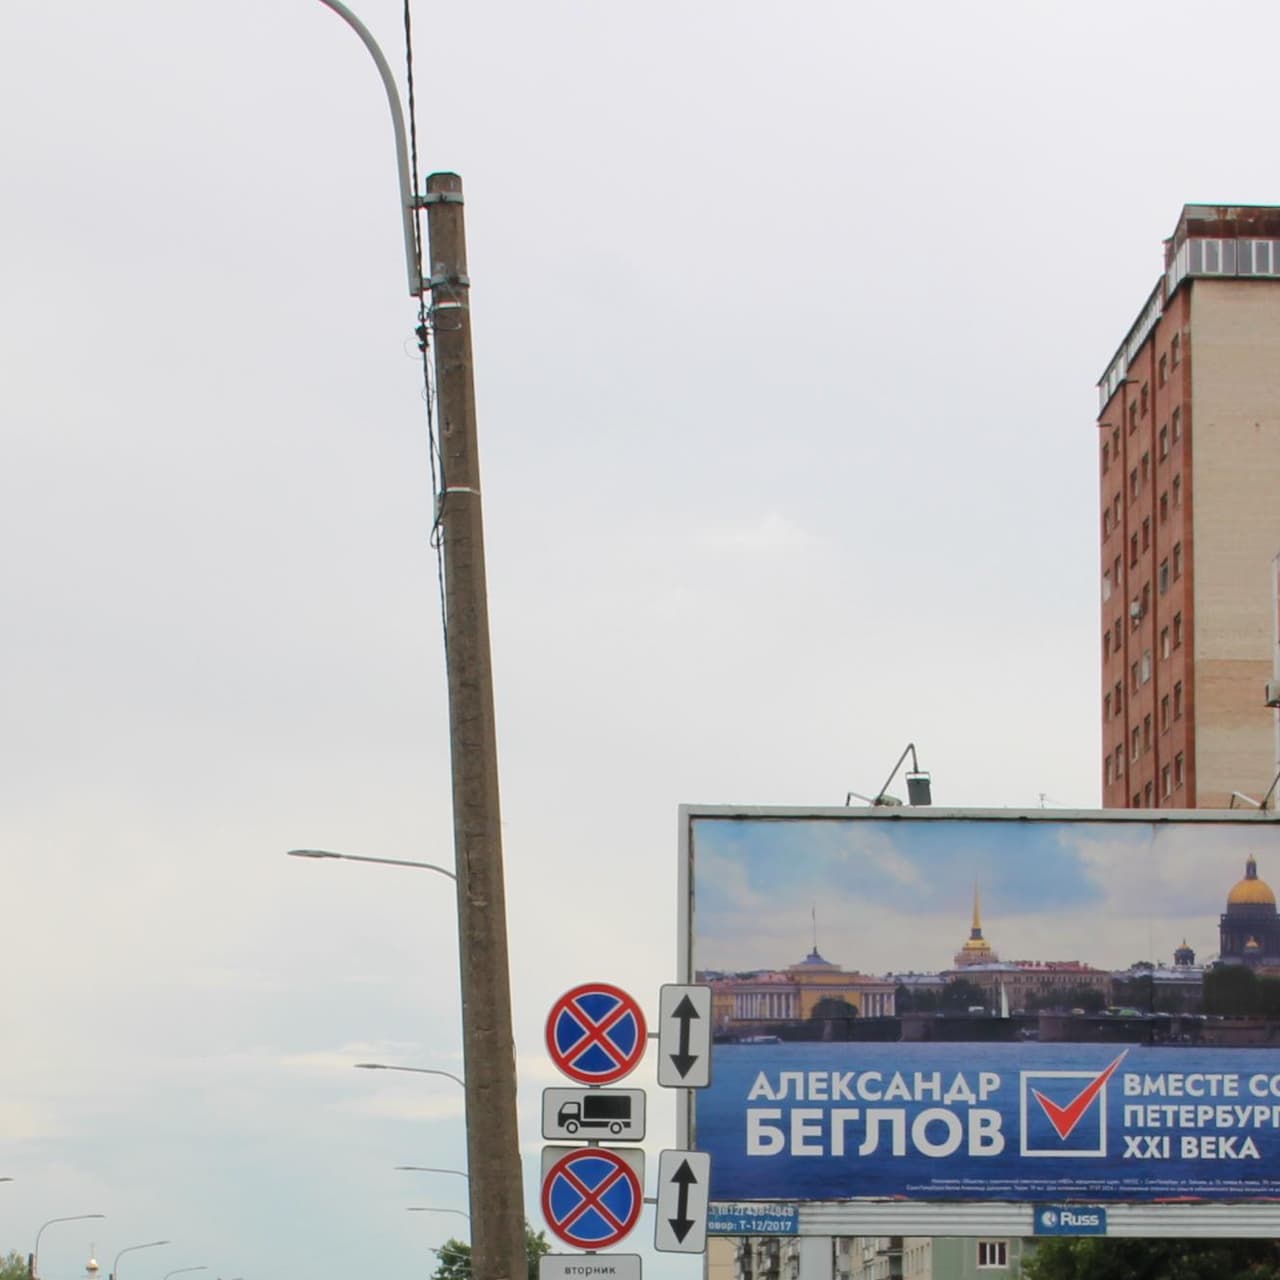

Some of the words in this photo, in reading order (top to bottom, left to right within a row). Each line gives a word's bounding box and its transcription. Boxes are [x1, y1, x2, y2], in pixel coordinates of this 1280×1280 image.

[747, 1071, 1001, 1105] АЛЕКСАНДР
[1123, 1073, 1239, 1098] ВМЕСТЕ
[746, 1108, 1005, 1158] БЕГЛОВ
[1180, 1136, 1261, 1160] ВЕКА
[1060, 1212, 1099, 1227] Russ
[564, 1265, 617, 1278] вторник
